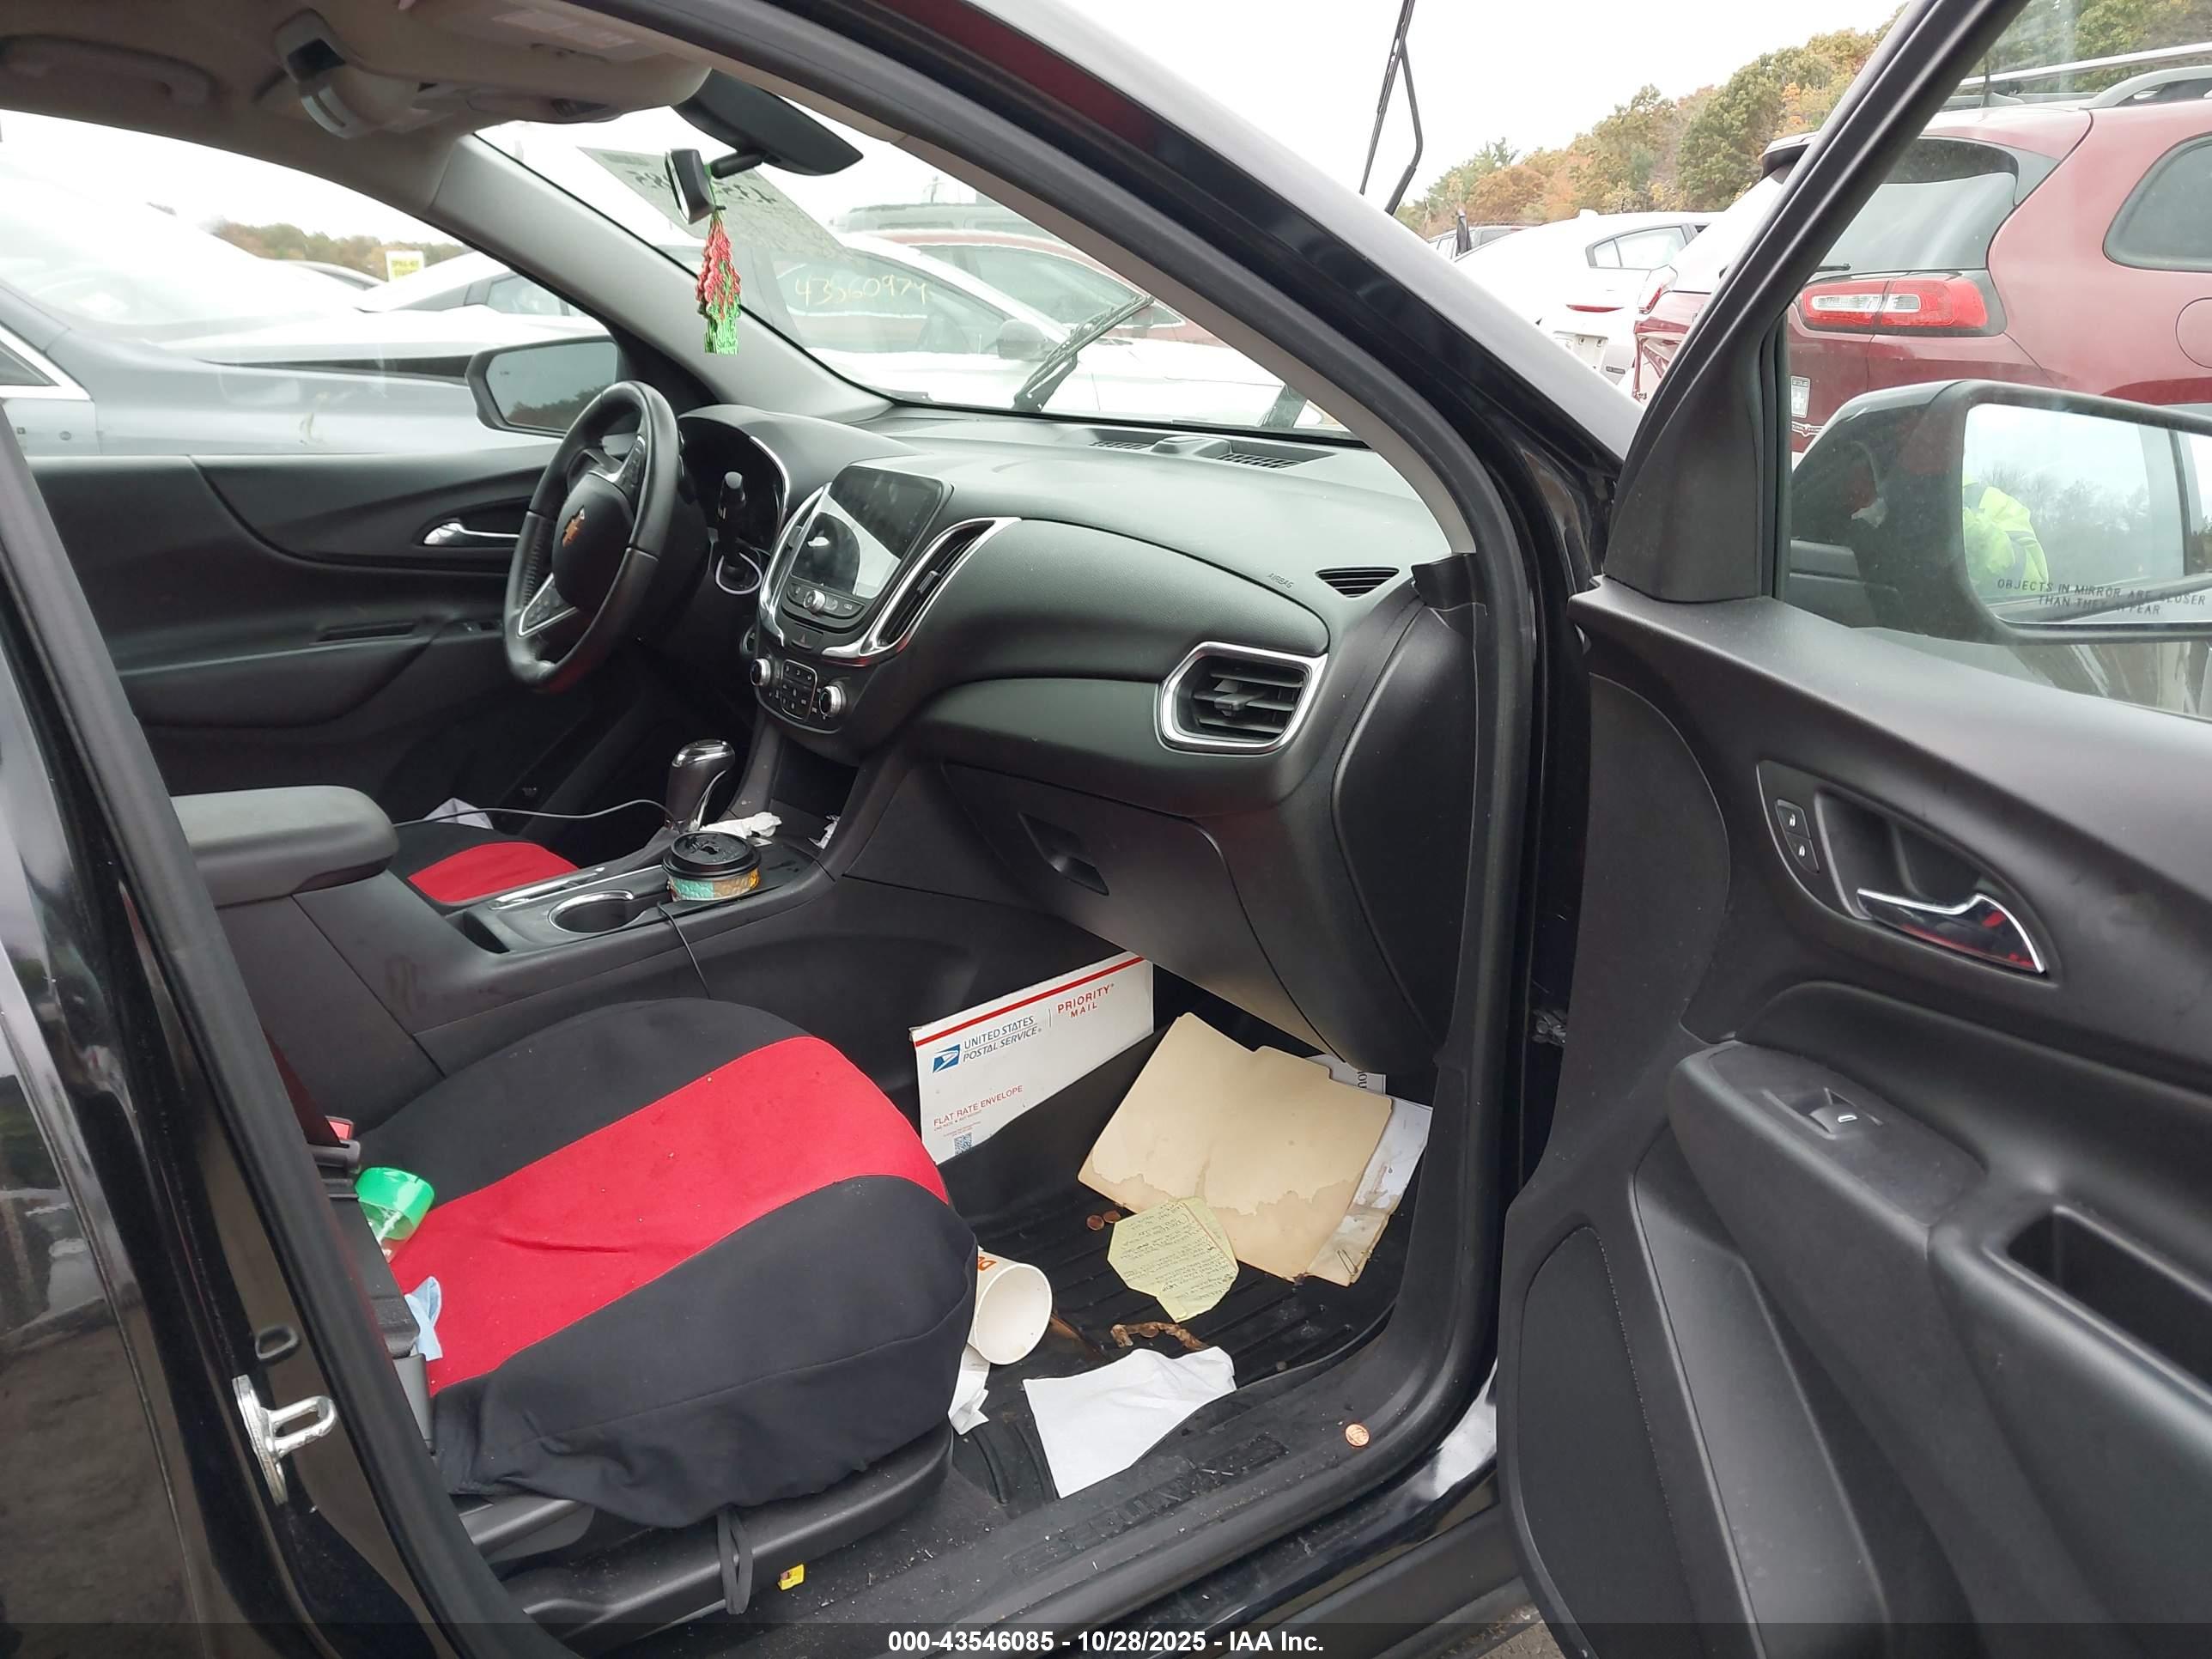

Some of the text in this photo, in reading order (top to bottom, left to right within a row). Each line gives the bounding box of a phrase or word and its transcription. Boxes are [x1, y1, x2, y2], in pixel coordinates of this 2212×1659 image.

[1996, 578, 2207, 606] OBJECTS IN MIRROR ARE LOSER
[2038, 594, 2070, 607] THAN
[1057, 984, 1110, 1014] PRIORITY
[1070, 1002, 1097, 1018] MAIL
[963, 1015, 1034, 1050] UNITED STATES
[963, 1040, 999, 1062] POSTAL
[933, 1112, 954, 1127] FLAT
[957, 1103, 979, 1118] RATE
[981, 1085, 1024, 1108] ENVELOPE
